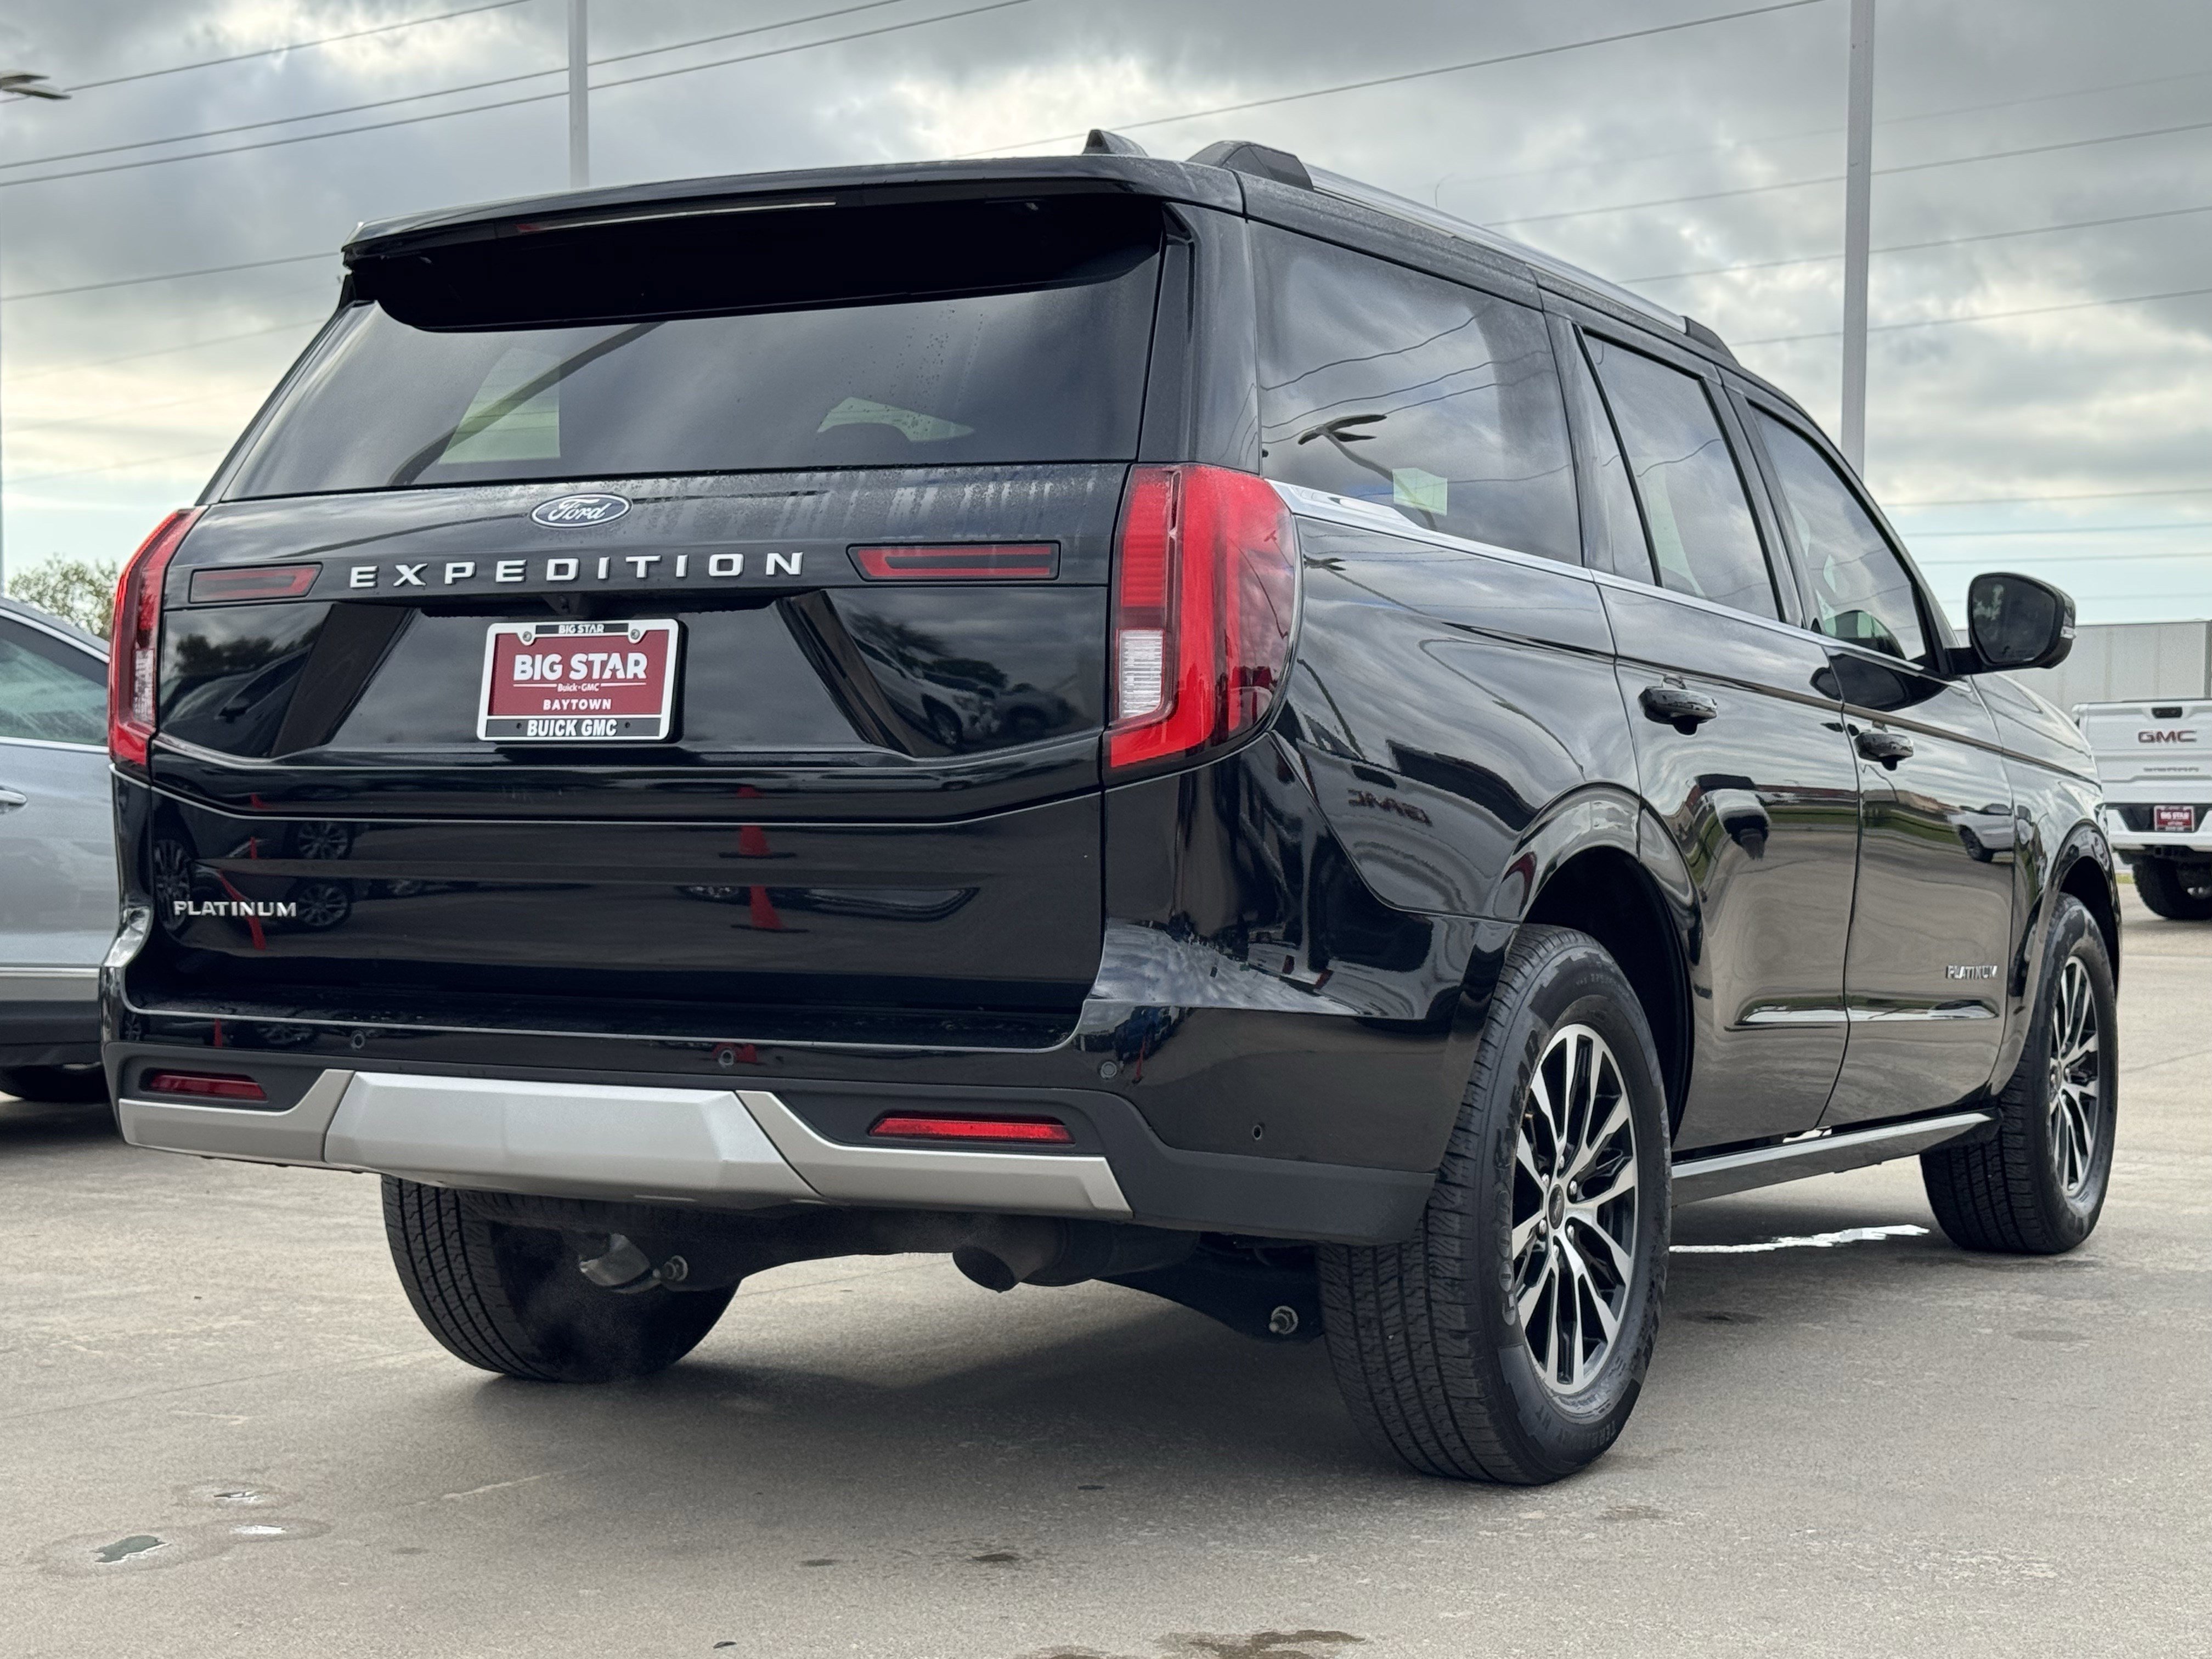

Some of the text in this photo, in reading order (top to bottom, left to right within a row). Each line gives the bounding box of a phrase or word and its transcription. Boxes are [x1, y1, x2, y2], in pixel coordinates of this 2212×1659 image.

[549, 498, 607, 521] Ford
[350, 551, 804, 589] EXPEDITION
[558, 623, 605, 634] BIG STAR
[513, 652, 648, 681] BIG STAR
[543, 698, 612, 710] BAYTOWN
[527, 719, 618, 737] BUICK GMC
[2138, 730, 2198, 743] GMC
[173, 900, 297, 917] PLATINUM
[1946, 965, 1998, 980] PLATINUM
